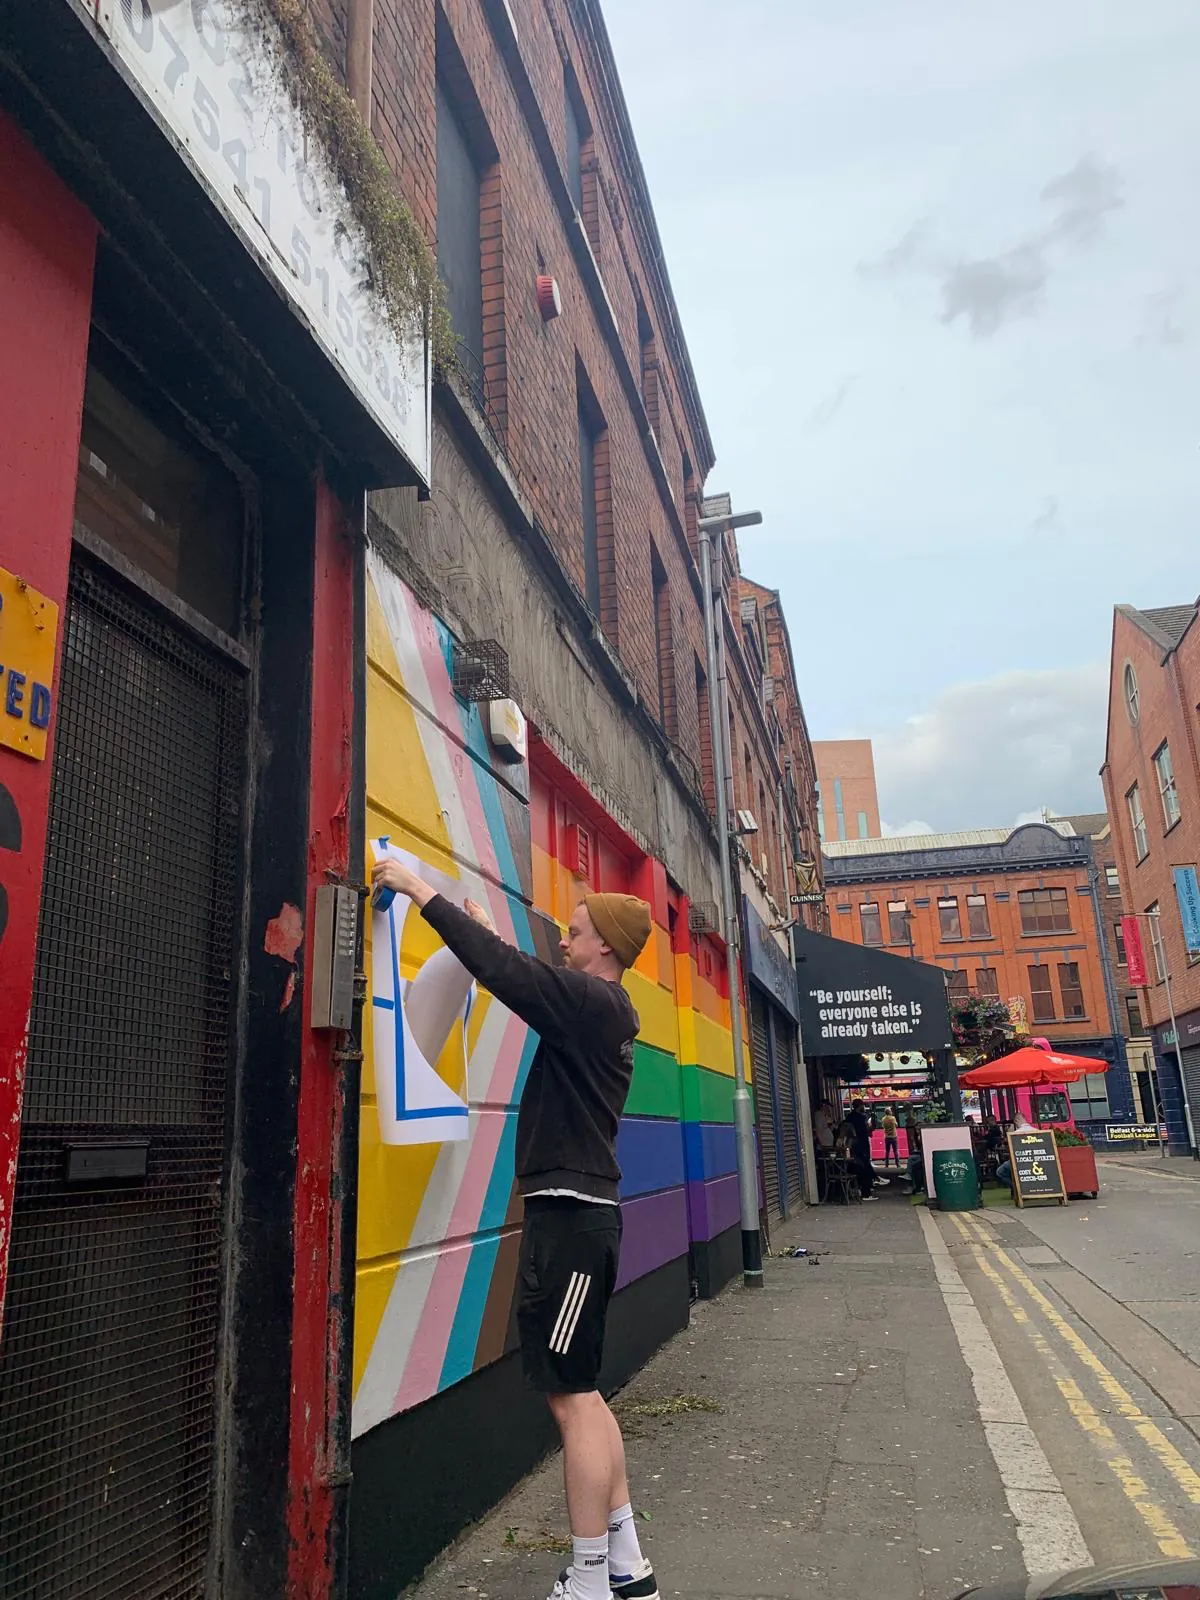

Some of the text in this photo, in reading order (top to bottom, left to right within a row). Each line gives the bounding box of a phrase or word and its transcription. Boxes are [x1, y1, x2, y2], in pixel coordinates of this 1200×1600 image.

[0, 664, 50, 729] ED
[791, 895, 824, 903] GUINNESS
[836, 985, 893, 1004] yourself;
[820, 1001, 922, 1021] everyone else is
[821, 1018, 920, 1038] already taken.”
[1032, 1161, 1044, 1175] &
